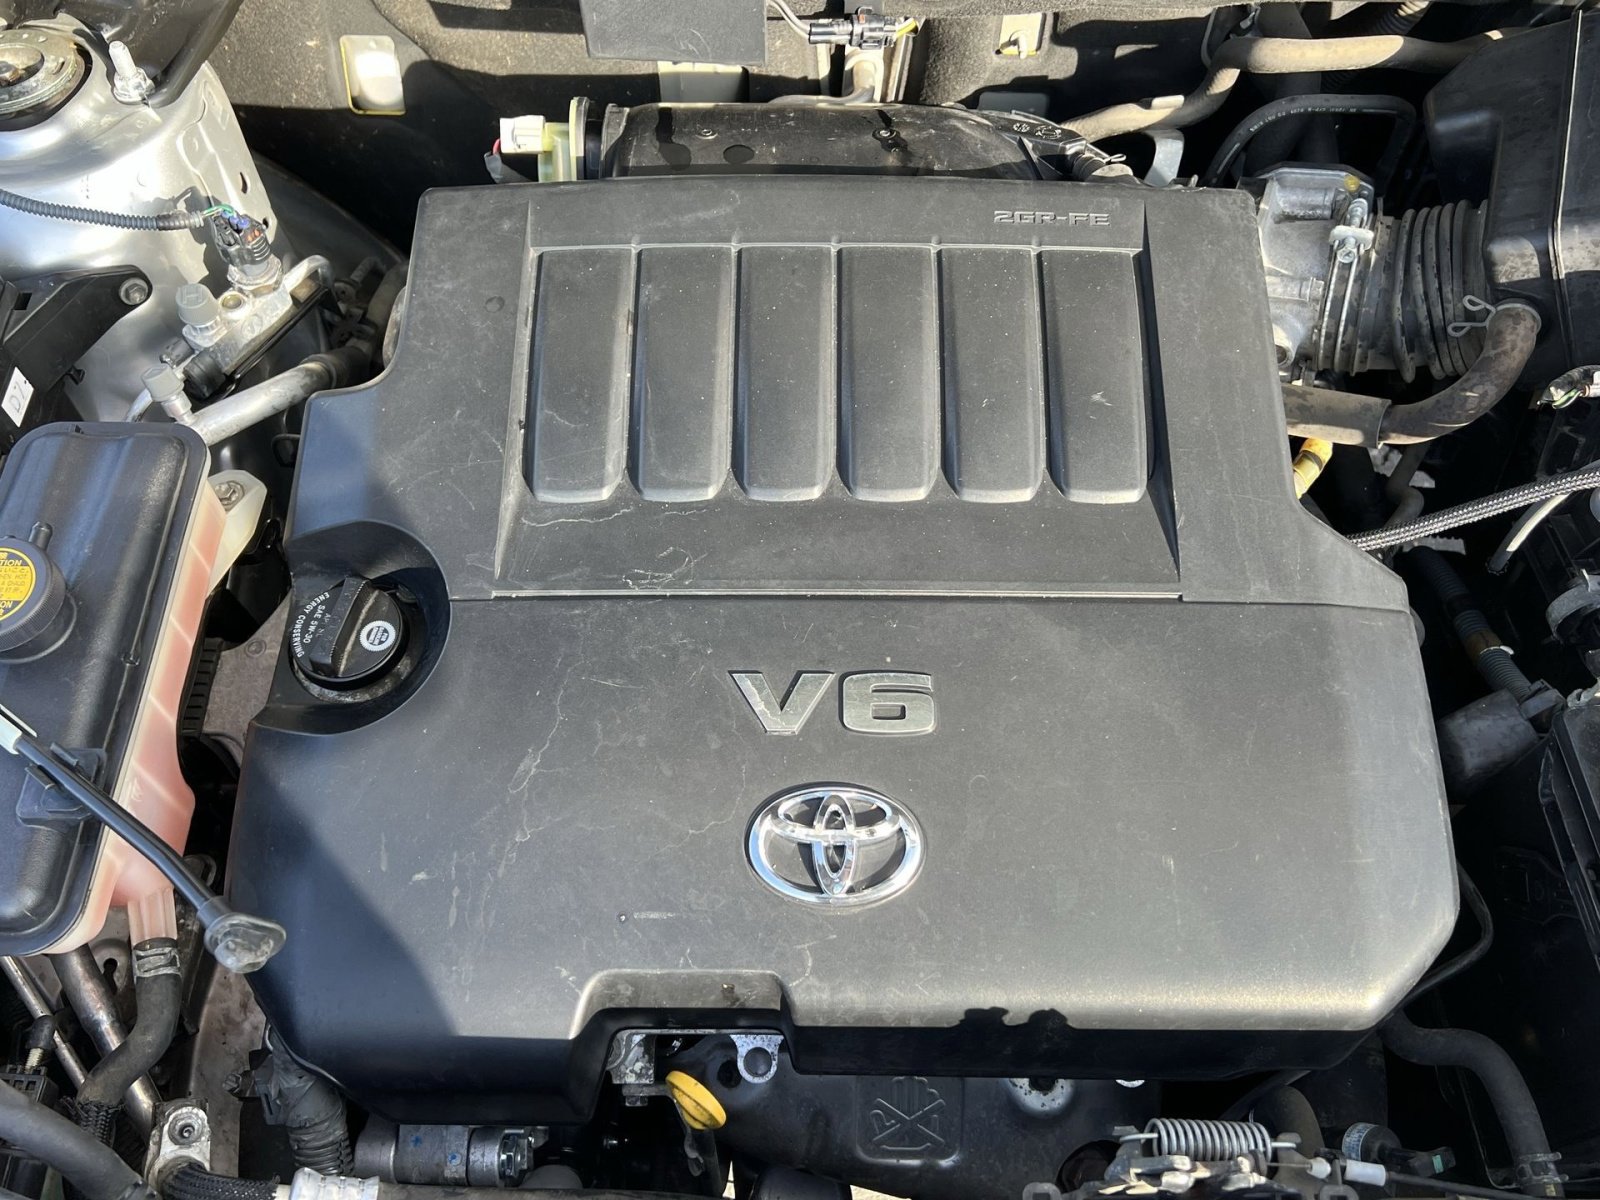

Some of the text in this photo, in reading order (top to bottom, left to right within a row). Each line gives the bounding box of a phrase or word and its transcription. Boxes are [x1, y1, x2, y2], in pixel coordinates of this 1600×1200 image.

[993, 210, 1110, 225] 2GR-FE
[292, 591, 330, 658] ENERGY CONSERVING
[303, 604, 326, 643] SAE 5W-30
[728, 670, 935, 735] V6
